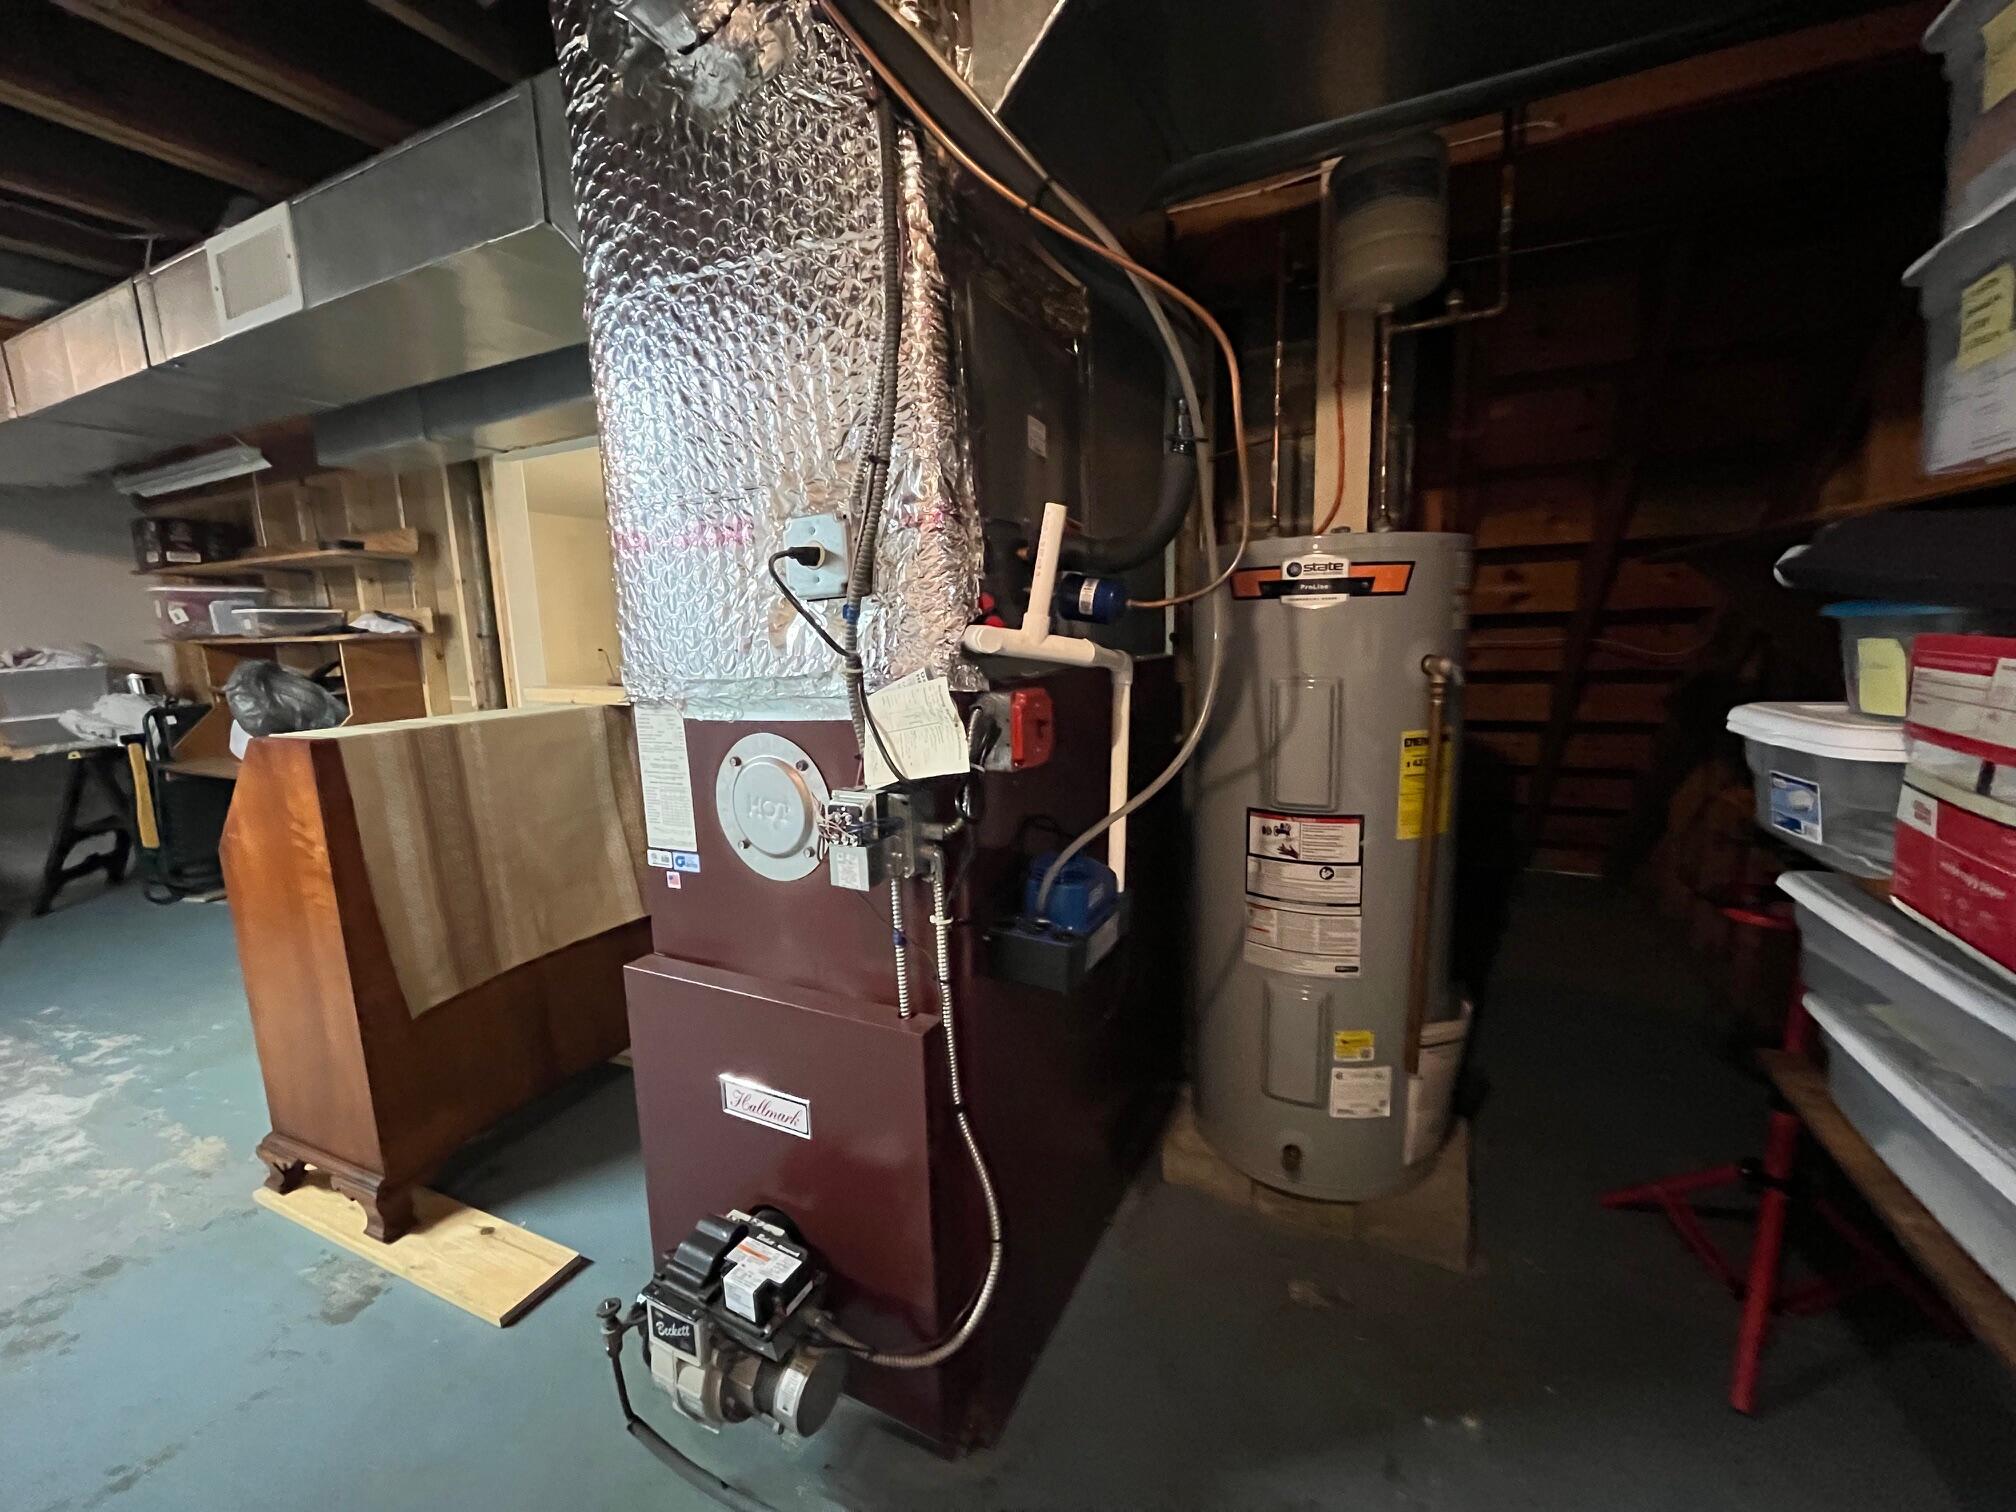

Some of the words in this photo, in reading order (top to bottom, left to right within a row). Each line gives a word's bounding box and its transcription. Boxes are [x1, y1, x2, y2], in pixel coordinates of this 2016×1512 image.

[1303, 562, 1344, 572] state
[730, 1089, 803, 1127] Hallmark
[655, 1320, 690, 1337] Beckett
